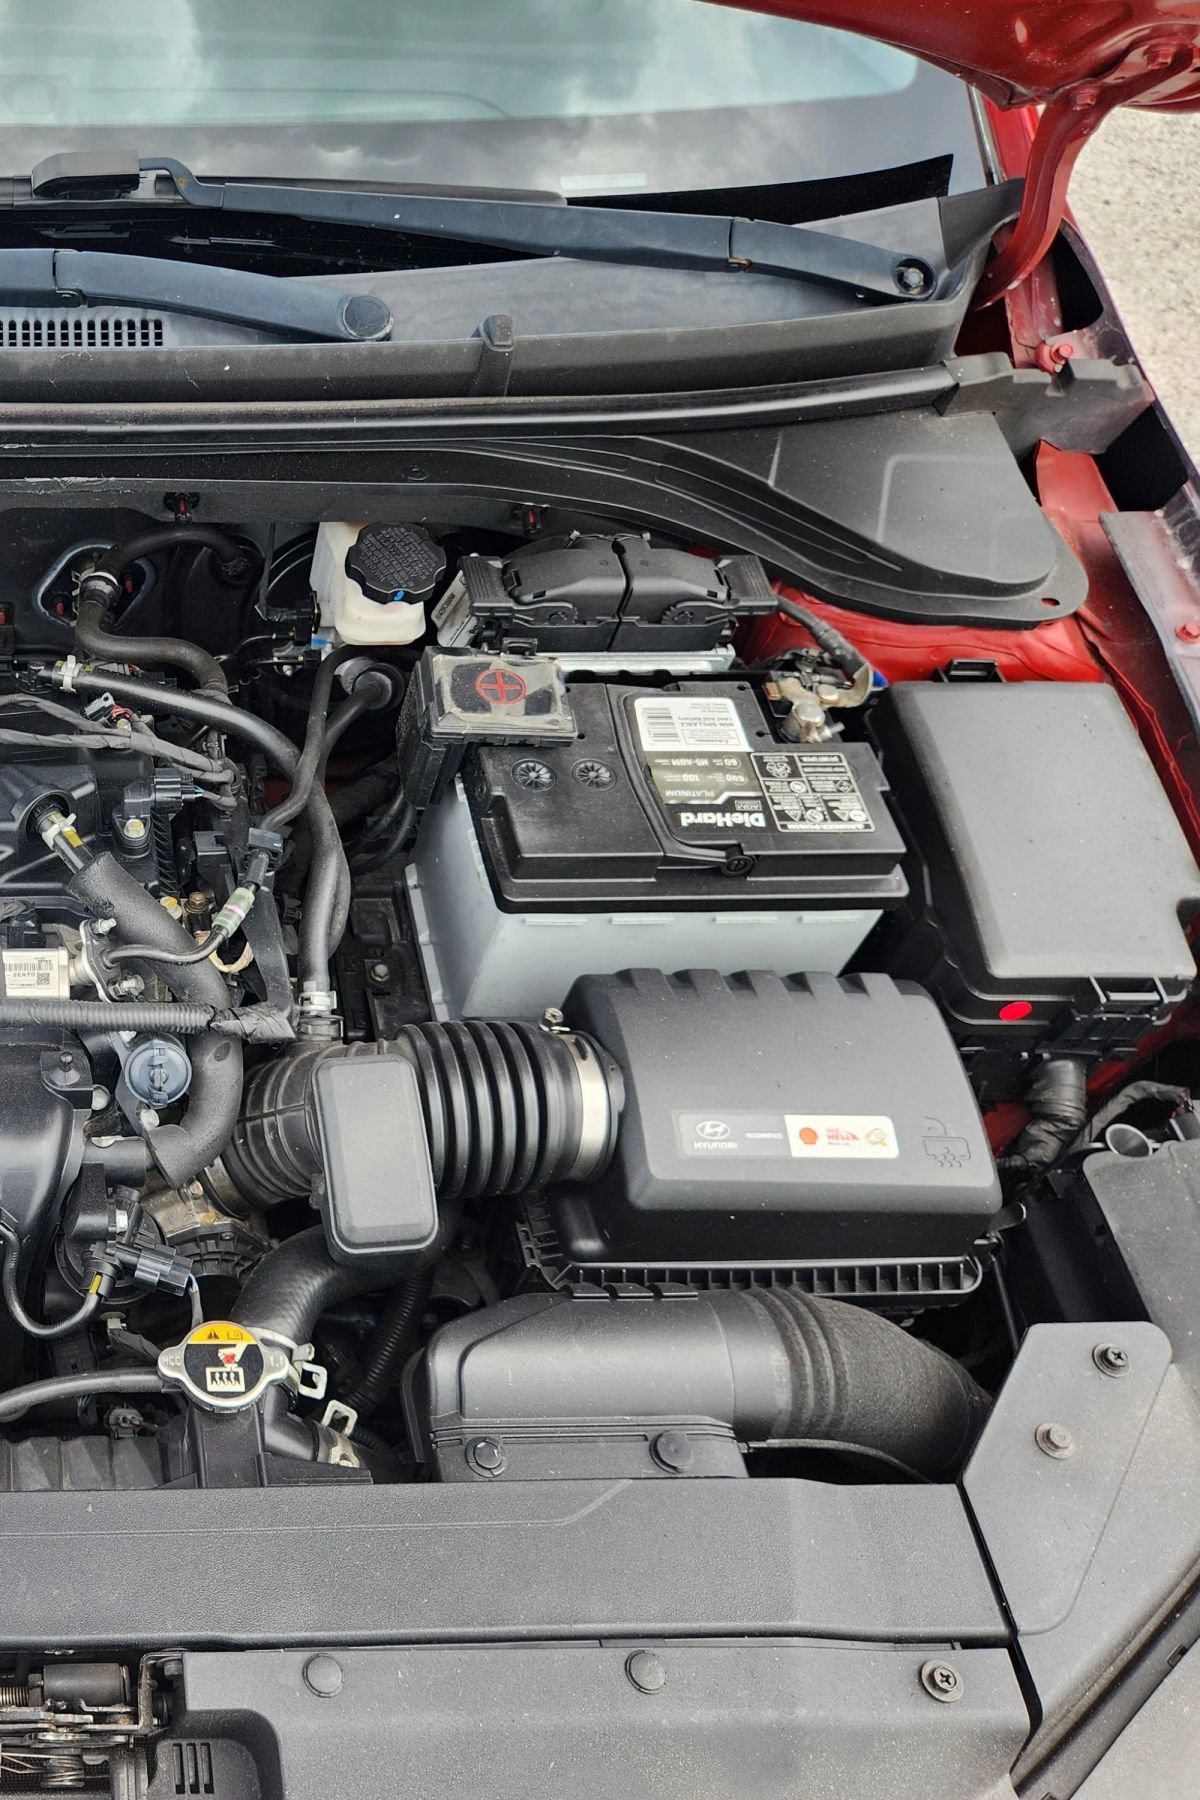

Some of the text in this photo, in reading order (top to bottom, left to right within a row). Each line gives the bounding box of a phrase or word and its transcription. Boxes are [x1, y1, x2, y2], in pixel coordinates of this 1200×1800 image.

[665, 789, 714, 797] PLATINUM
[680, 812, 767, 828] DieHard
[693, 1141, 738, 1150] HYUNDAI
